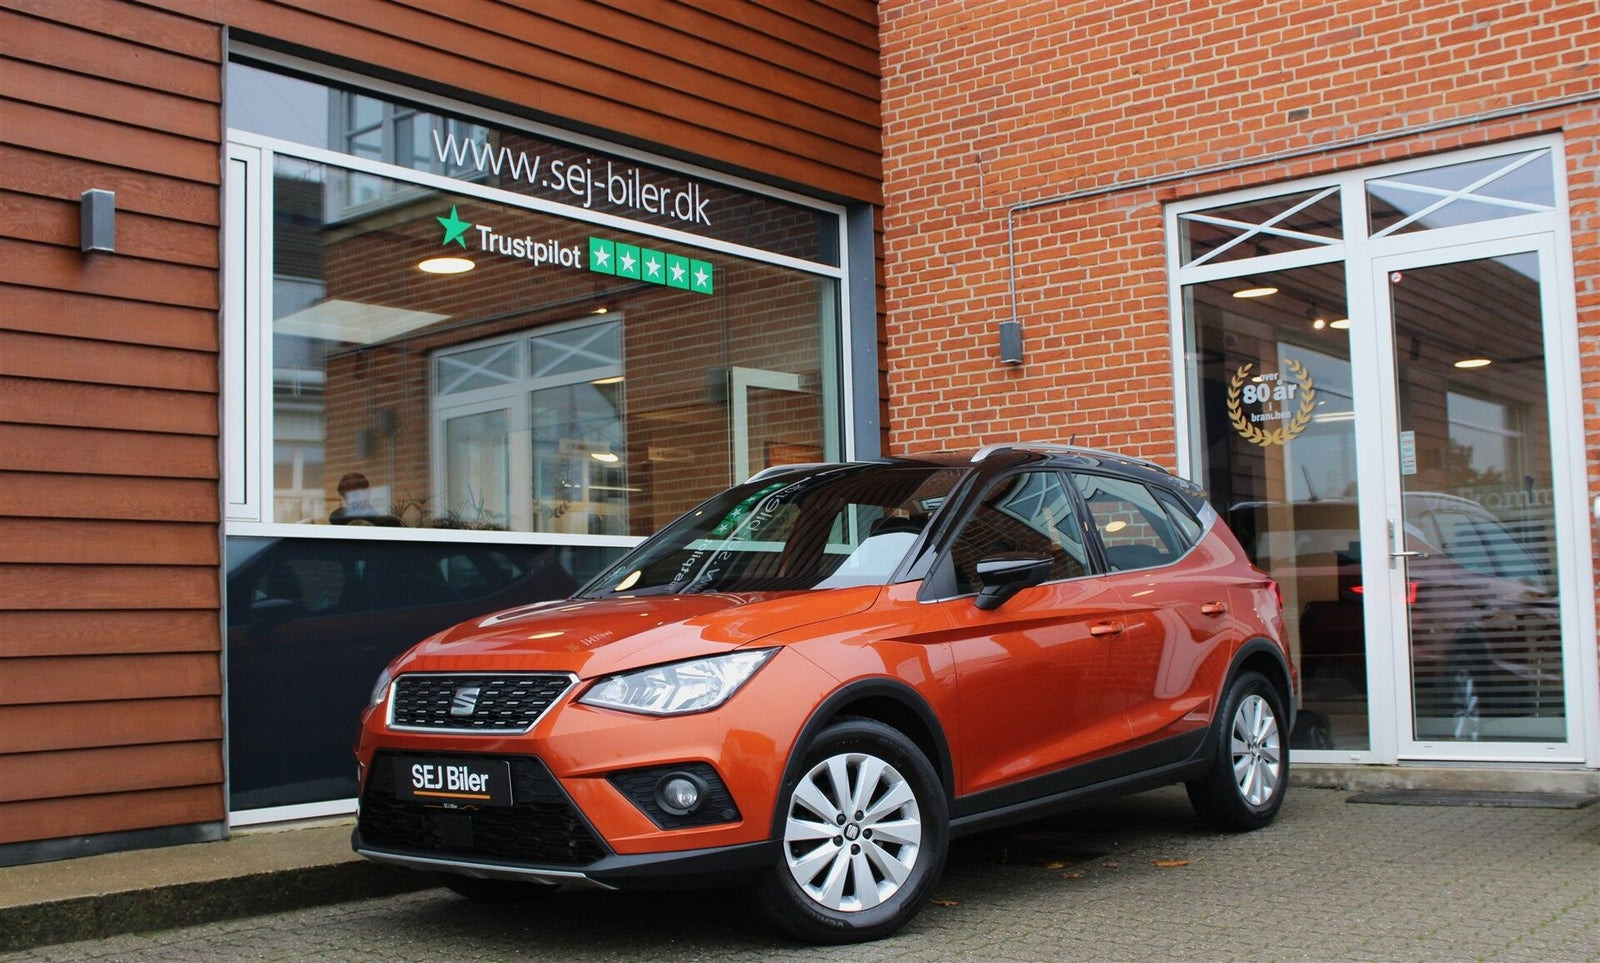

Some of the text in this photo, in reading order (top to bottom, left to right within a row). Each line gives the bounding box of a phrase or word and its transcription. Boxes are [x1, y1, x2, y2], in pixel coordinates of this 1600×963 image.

[432, 128, 711, 227] www.sej-biler.dk
[475, 224, 582, 269] Trustpilot
[1260, 372, 1279, 382] over
[1242, 379, 1297, 405] 80 år
[1250, 410, 1291, 422] branchen
[411, 763, 489, 792] SEJ Biler
